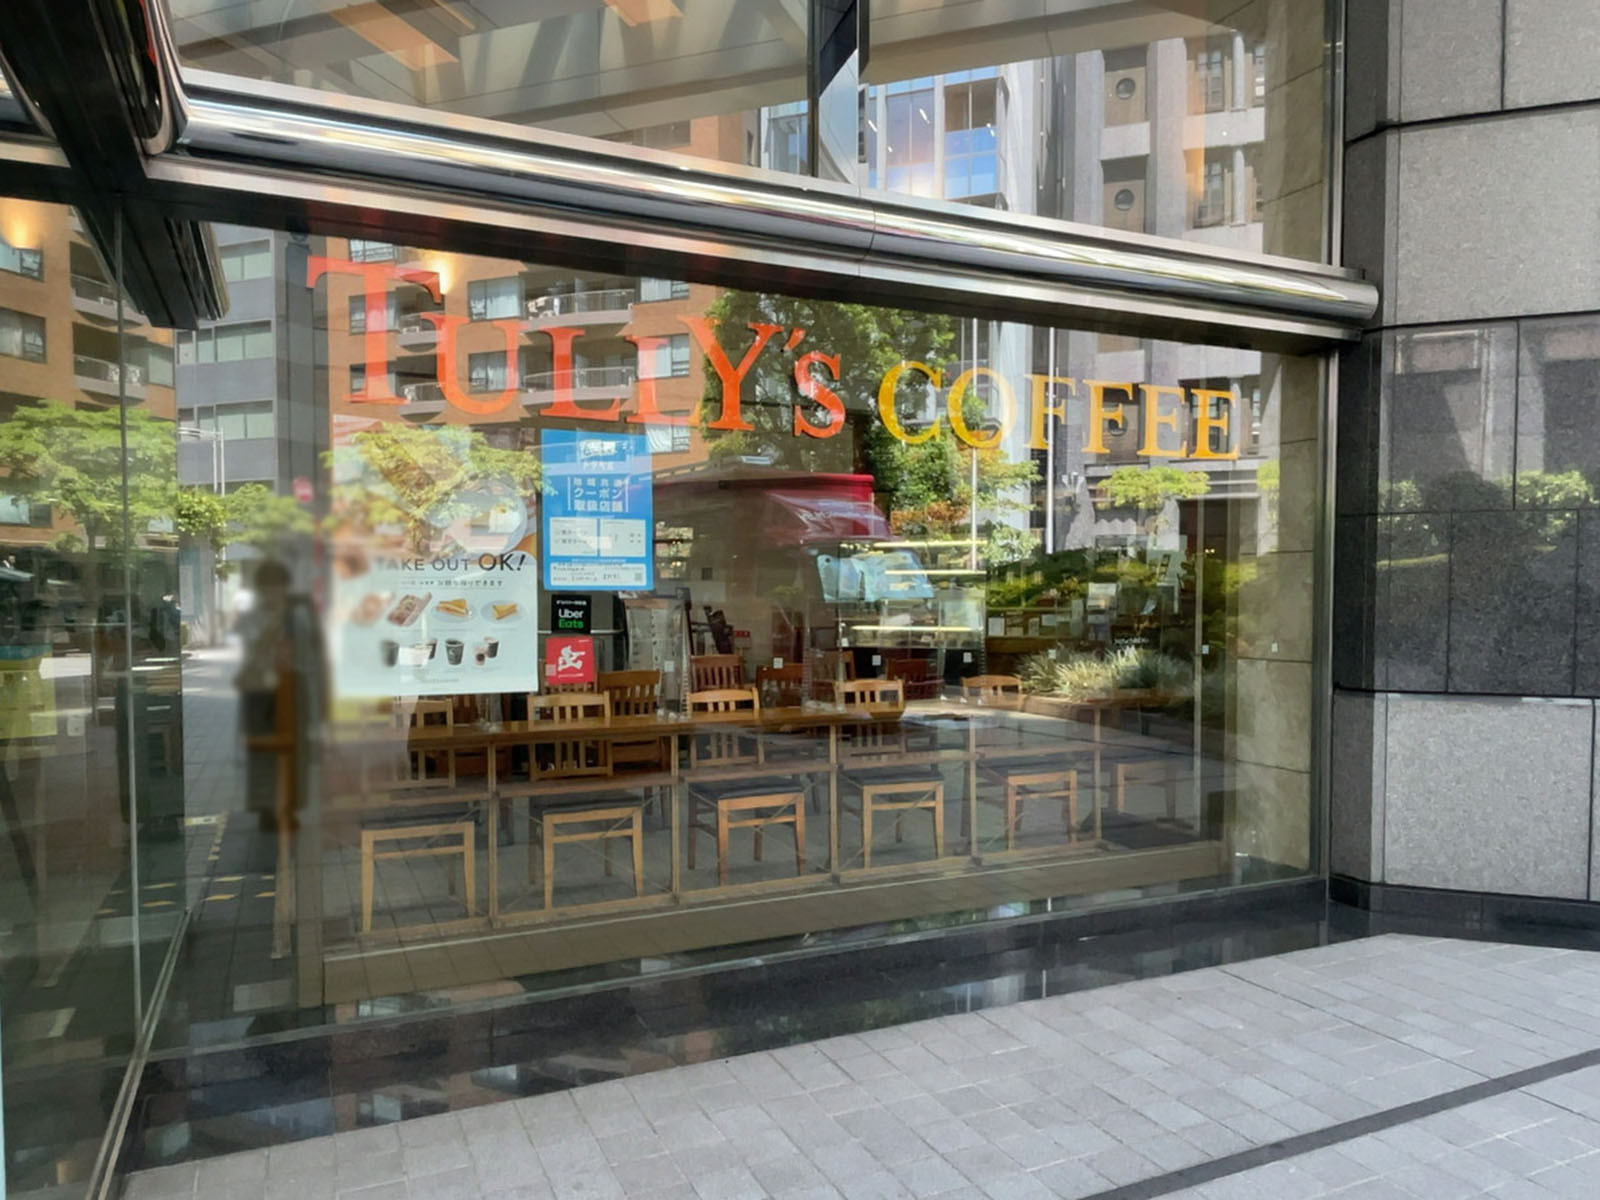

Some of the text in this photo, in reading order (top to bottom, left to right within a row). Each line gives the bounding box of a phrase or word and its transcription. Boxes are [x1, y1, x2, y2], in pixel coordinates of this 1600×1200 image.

[307, 256, 1239, 460] TULLY'S COFFEE
[573, 488, 623, 499] クーポン
[431, 558, 470, 571] OUT
[478, 552, 526, 571] OK!
[558, 608, 584, 619] Uber
[558, 619, 584, 629] Eats
